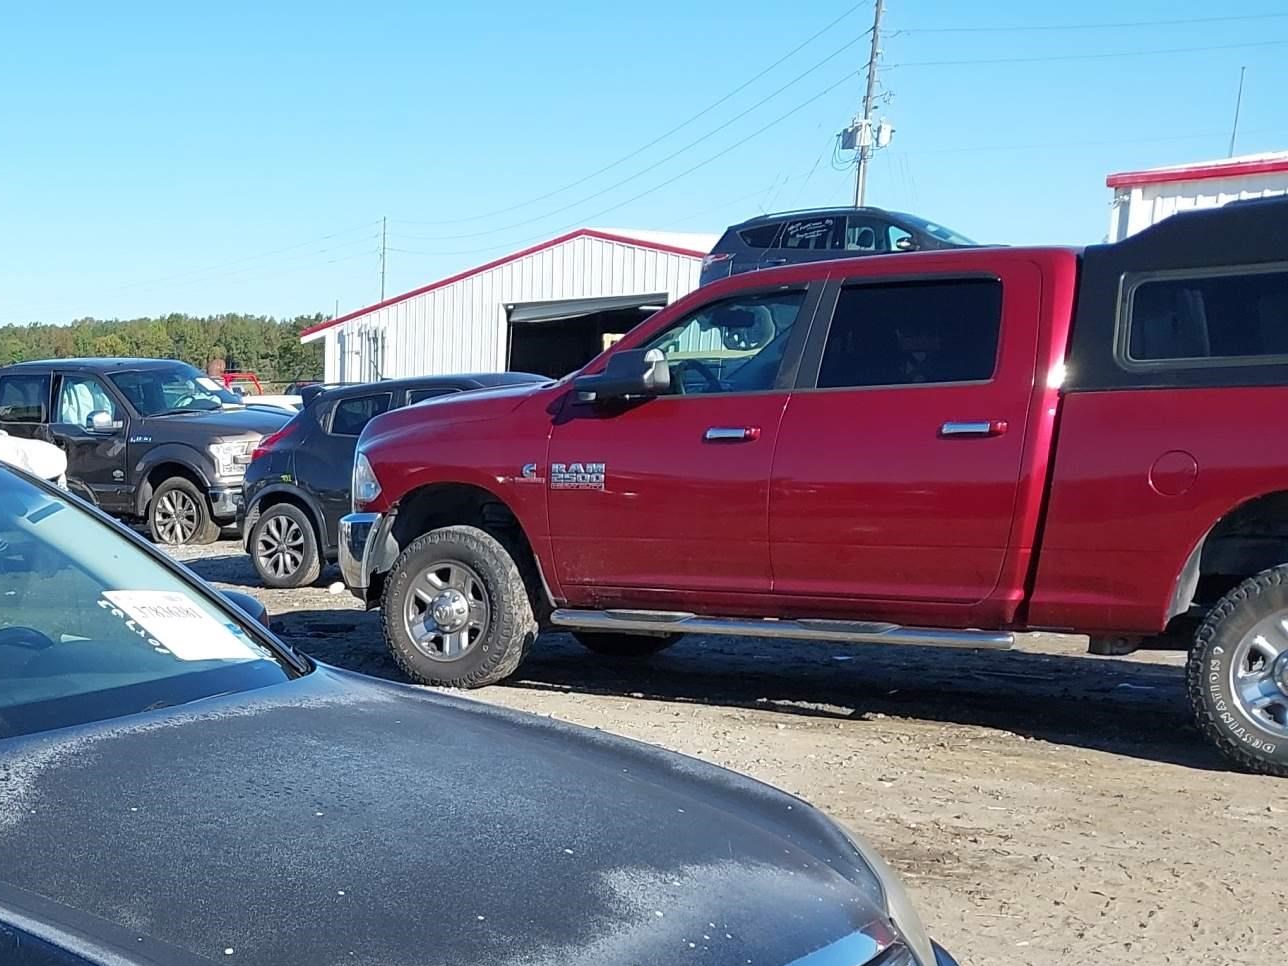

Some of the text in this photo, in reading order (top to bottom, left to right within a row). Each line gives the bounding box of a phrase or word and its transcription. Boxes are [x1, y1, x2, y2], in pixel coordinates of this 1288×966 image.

[551, 463, 606, 473] RAM
[551, 473, 605, 483] 2500
[1209, 659, 1275, 754] DESTINATION
